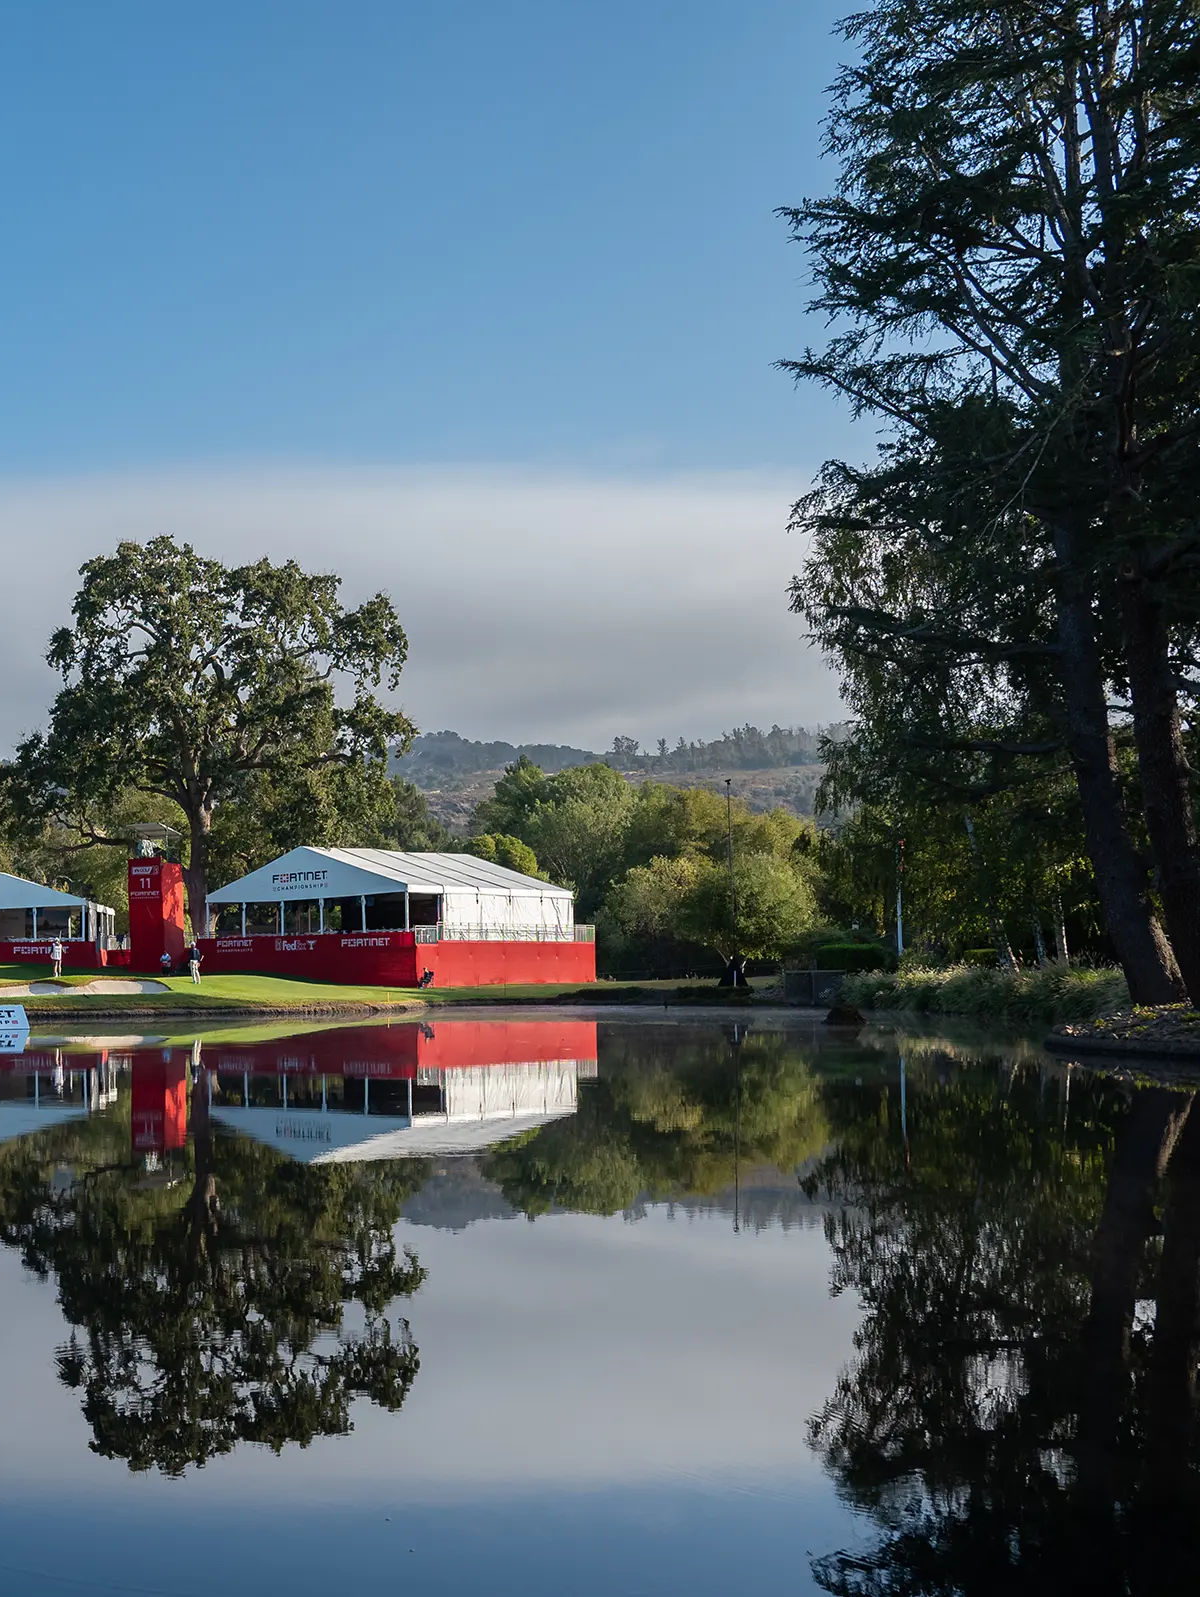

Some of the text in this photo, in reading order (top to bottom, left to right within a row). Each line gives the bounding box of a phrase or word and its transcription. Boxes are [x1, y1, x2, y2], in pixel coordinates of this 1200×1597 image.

[272, 870, 328, 884] FORTINET
[139, 877, 151, 889] 11
[277, 883, 323, 892] CHAMPIONSHIP
[216, 939, 253, 948] FORTINET
[282, 940, 307, 951] FedEx
[341, 937, 390, 948] FORTINET
[13, 945, 69, 955] FORTIT
